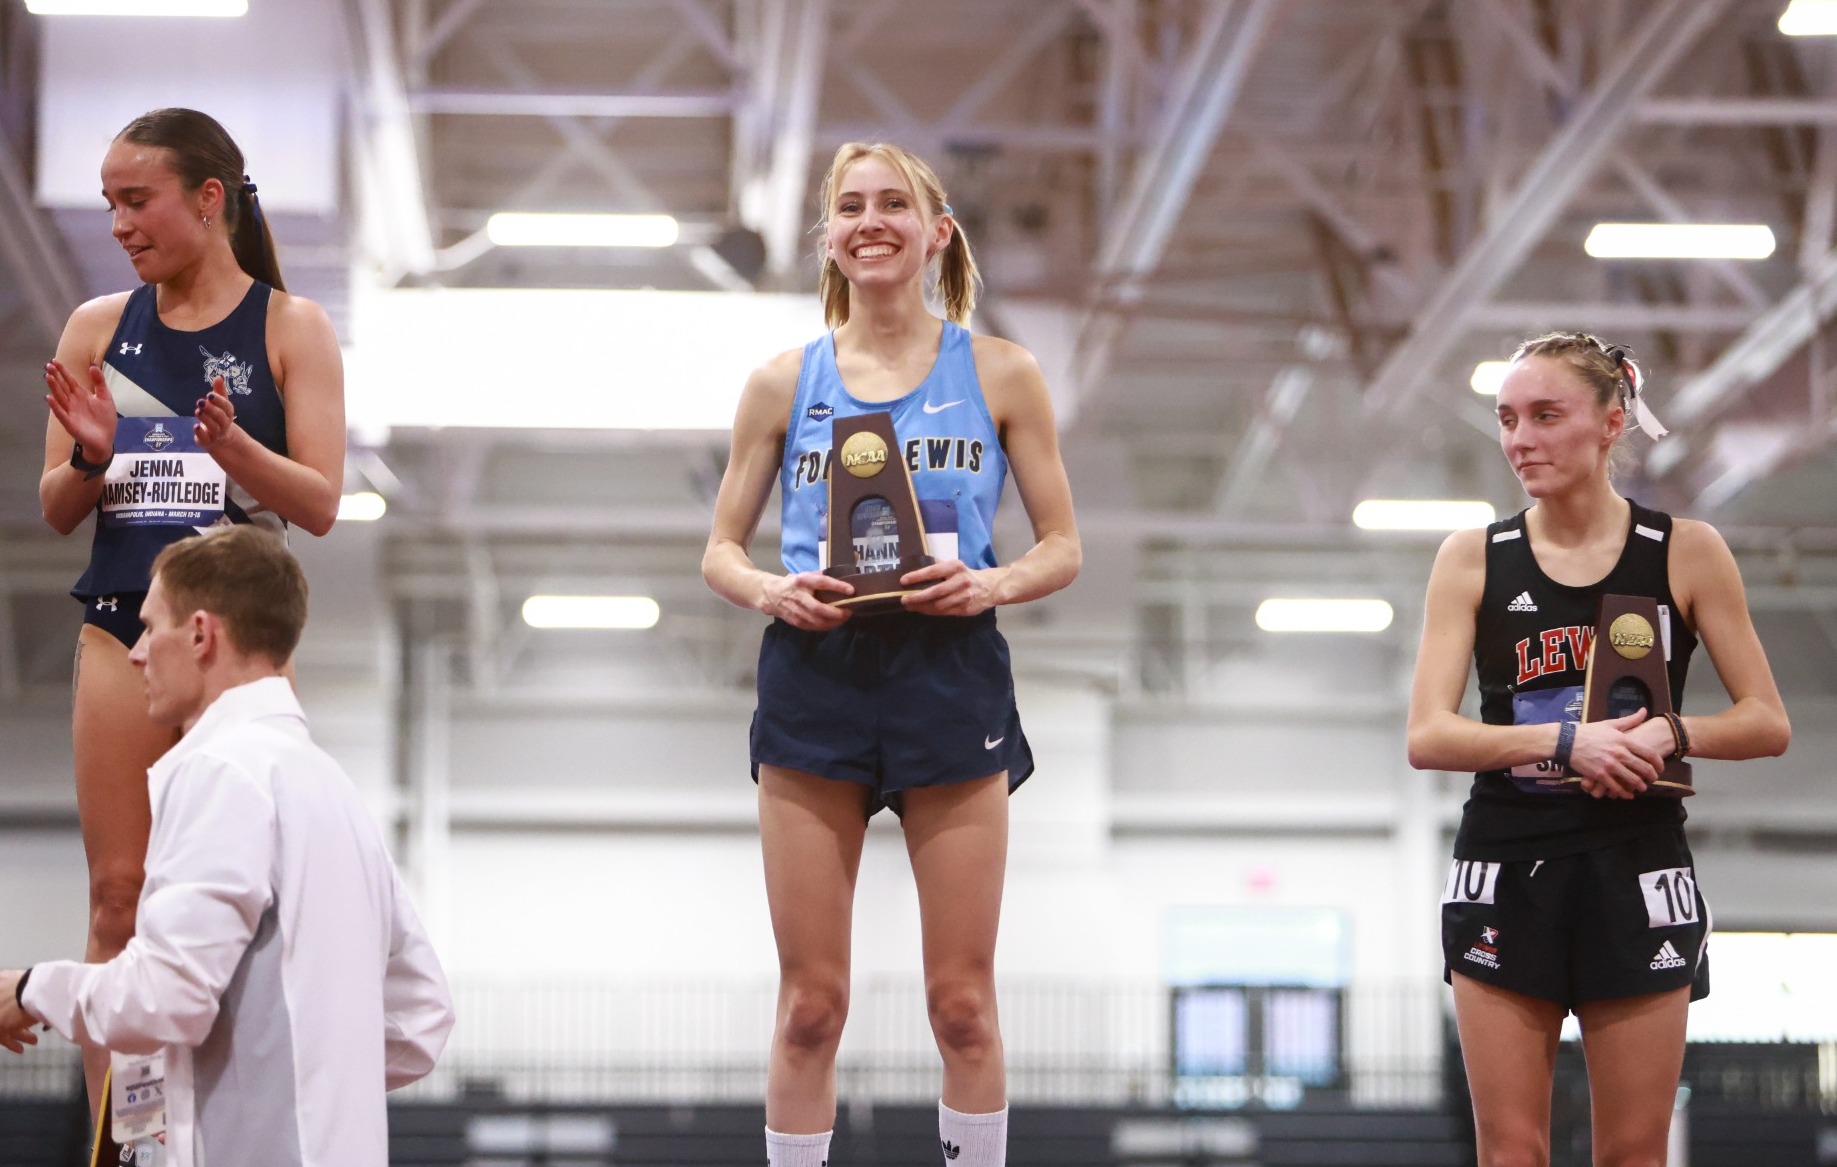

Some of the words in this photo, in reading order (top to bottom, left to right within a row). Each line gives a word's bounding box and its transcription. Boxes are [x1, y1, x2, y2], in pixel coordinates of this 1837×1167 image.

[808, 407, 833, 416] RMAC
[795, 448, 832, 489] FO
[904, 437, 983, 475] EWIS
[846, 450, 886, 467] NCAA
[130, 460, 185, 478] JENNA
[104, 481, 220, 505] RAMSEY-RUTLEDGE
[1507, 603, 1538, 612] adidas
[1515, 625, 1595, 685] LEW
[1452, 860, 1489, 901] 10
[1653, 870, 1693, 923] 10
[1463, 952, 1501, 969] COUNTRY
[1470, 947, 1498, 961] CROSS
[1650, 957, 1687, 970] adidas
